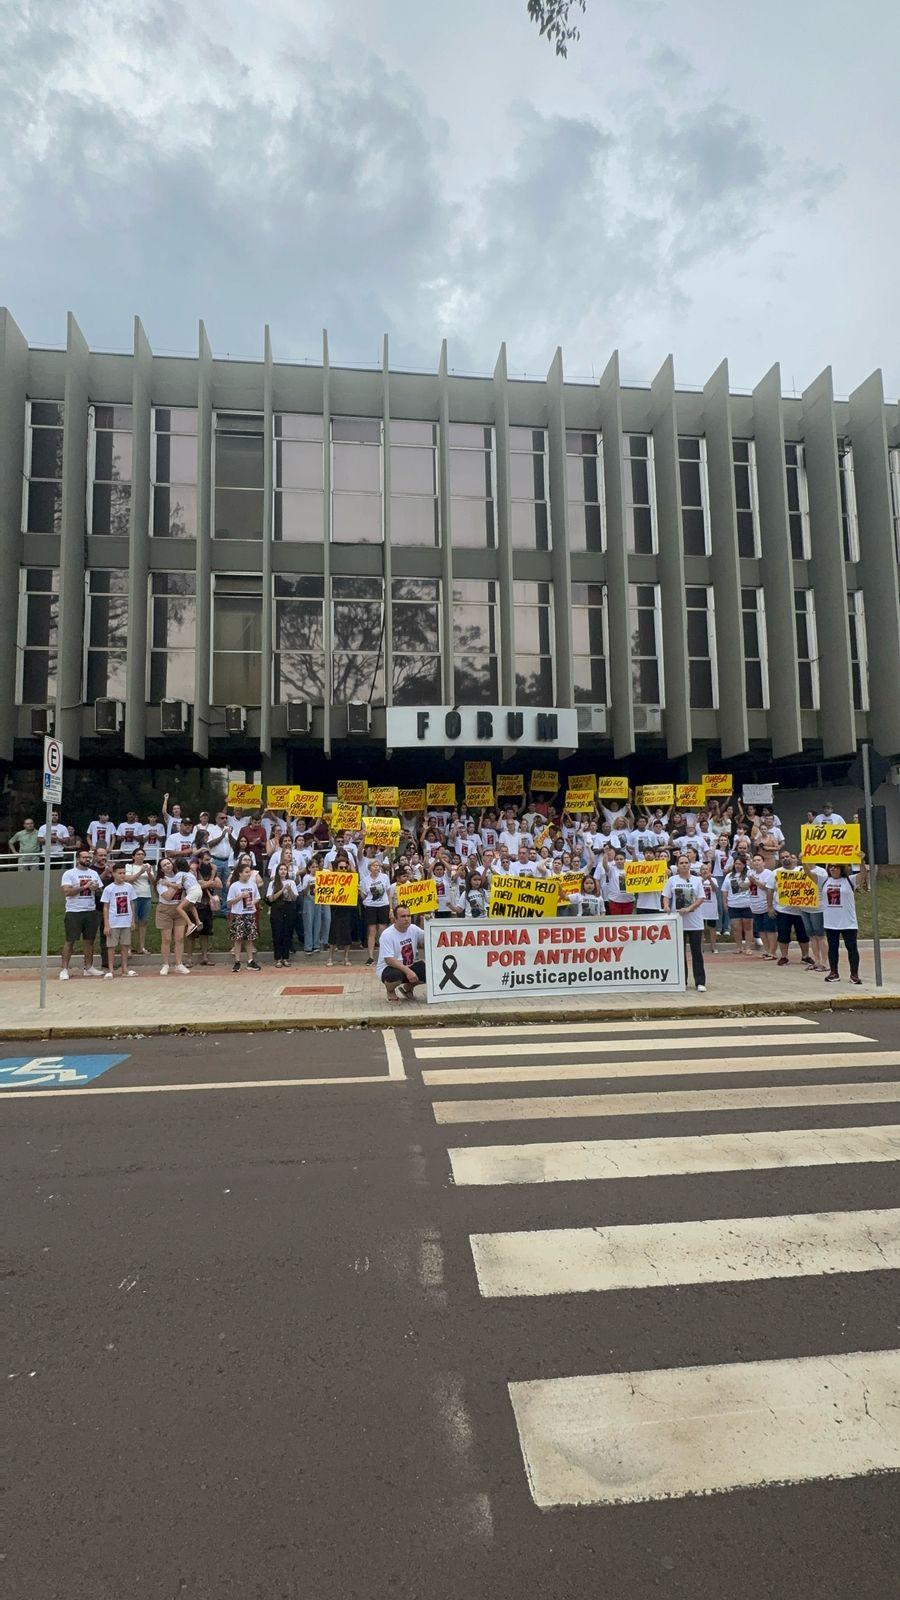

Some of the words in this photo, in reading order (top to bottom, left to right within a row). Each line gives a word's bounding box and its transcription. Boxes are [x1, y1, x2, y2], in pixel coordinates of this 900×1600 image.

[416, 705, 559, 741] FÓRUM
[50, 748, 57, 768] E
[805, 825, 827, 841] NÃO
[831, 828, 848, 840] FOI
[804, 844, 859, 857] ACIDENTE!
[494, 890, 512, 901] MEU
[535, 881, 556, 894] PELO
[491, 902, 544, 918] ANTHONY
[437, 928, 531, 948] ARARUNA
[538, 927, 586, 944] PEDE
[594, 924, 671, 944] JUSTIÇA
[486, 950, 526, 967] POR
[534, 947, 625, 965] ANTHONY
[501, 967, 670, 988] #justicapeloanthony
